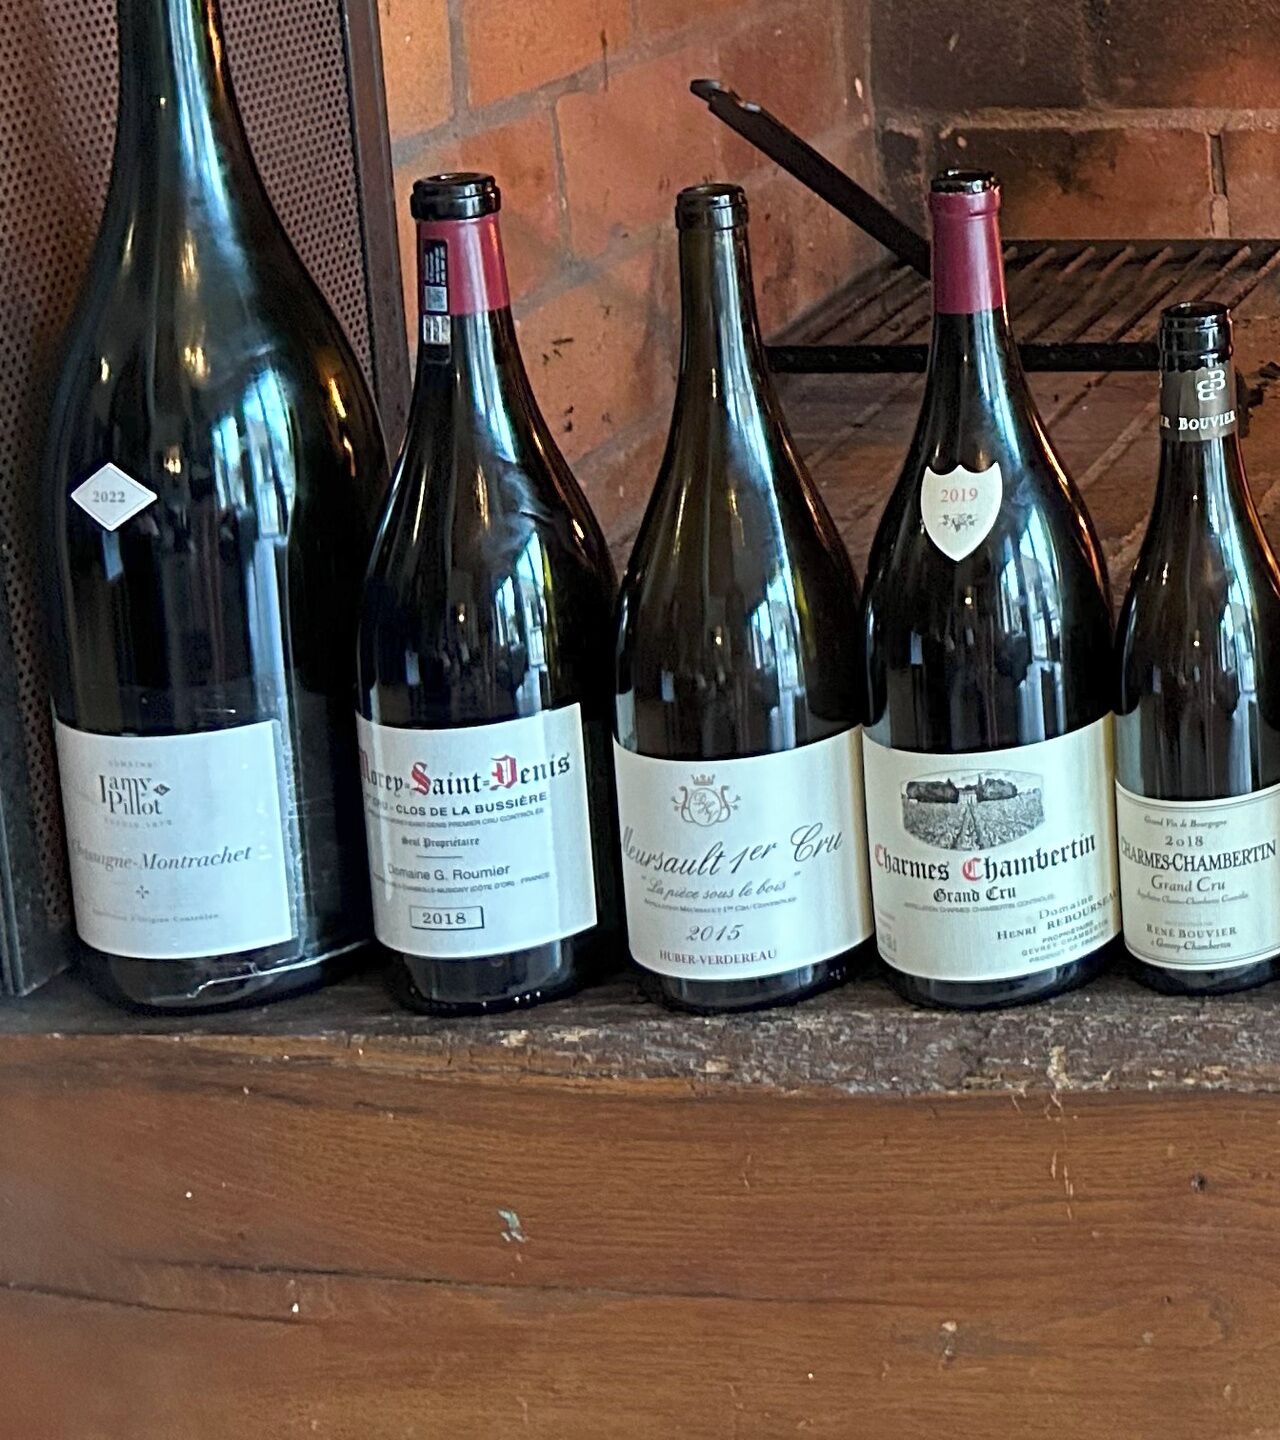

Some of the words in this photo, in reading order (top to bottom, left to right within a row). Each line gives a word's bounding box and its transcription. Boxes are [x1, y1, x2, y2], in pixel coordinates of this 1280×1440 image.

[1178, 410, 1236, 431] BOUVIER
[92, 490, 126, 504] 2022
[940, 487, 979, 503] 2019
[395, 805, 427, 817] CLOS
[430, 806, 448, 817] DE
[452, 804, 470, 816] LA
[474, 791, 548, 814] BUSSIÈRE
[729, 841, 778, 874] 1er
[790, 821, 844, 863] Cru
[1164, 835, 1205, 847] 2018
[874, 843, 950, 882] Charmes
[962, 832, 1096, 883] Chambertin
[1121, 835, 1277, 873] CHARMES-CHAMBERTIN
[388, 864, 431, 882] Domaine
[433, 869, 449, 881] G.
[452, 863, 511, 881] Roumier
[702, 886, 735, 900] sous
[737, 883, 754, 898] le
[755, 879, 787, 896] bois
[1151, 874, 1193, 892] Grand
[1196, 876, 1227, 892] Cru
[933, 887, 981, 904] Grand
[985, 885, 1017, 901] Cru
[1038, 894, 1094, 921] Domaine
[422, 911, 467, 926] 2018
[685, 923, 745, 942] 2015
[996, 925, 1037, 942] HENRI
[1178, 926, 1238, 939] BOUVIER
[659, 947, 778, 966] HUBER-VERDEREAU
